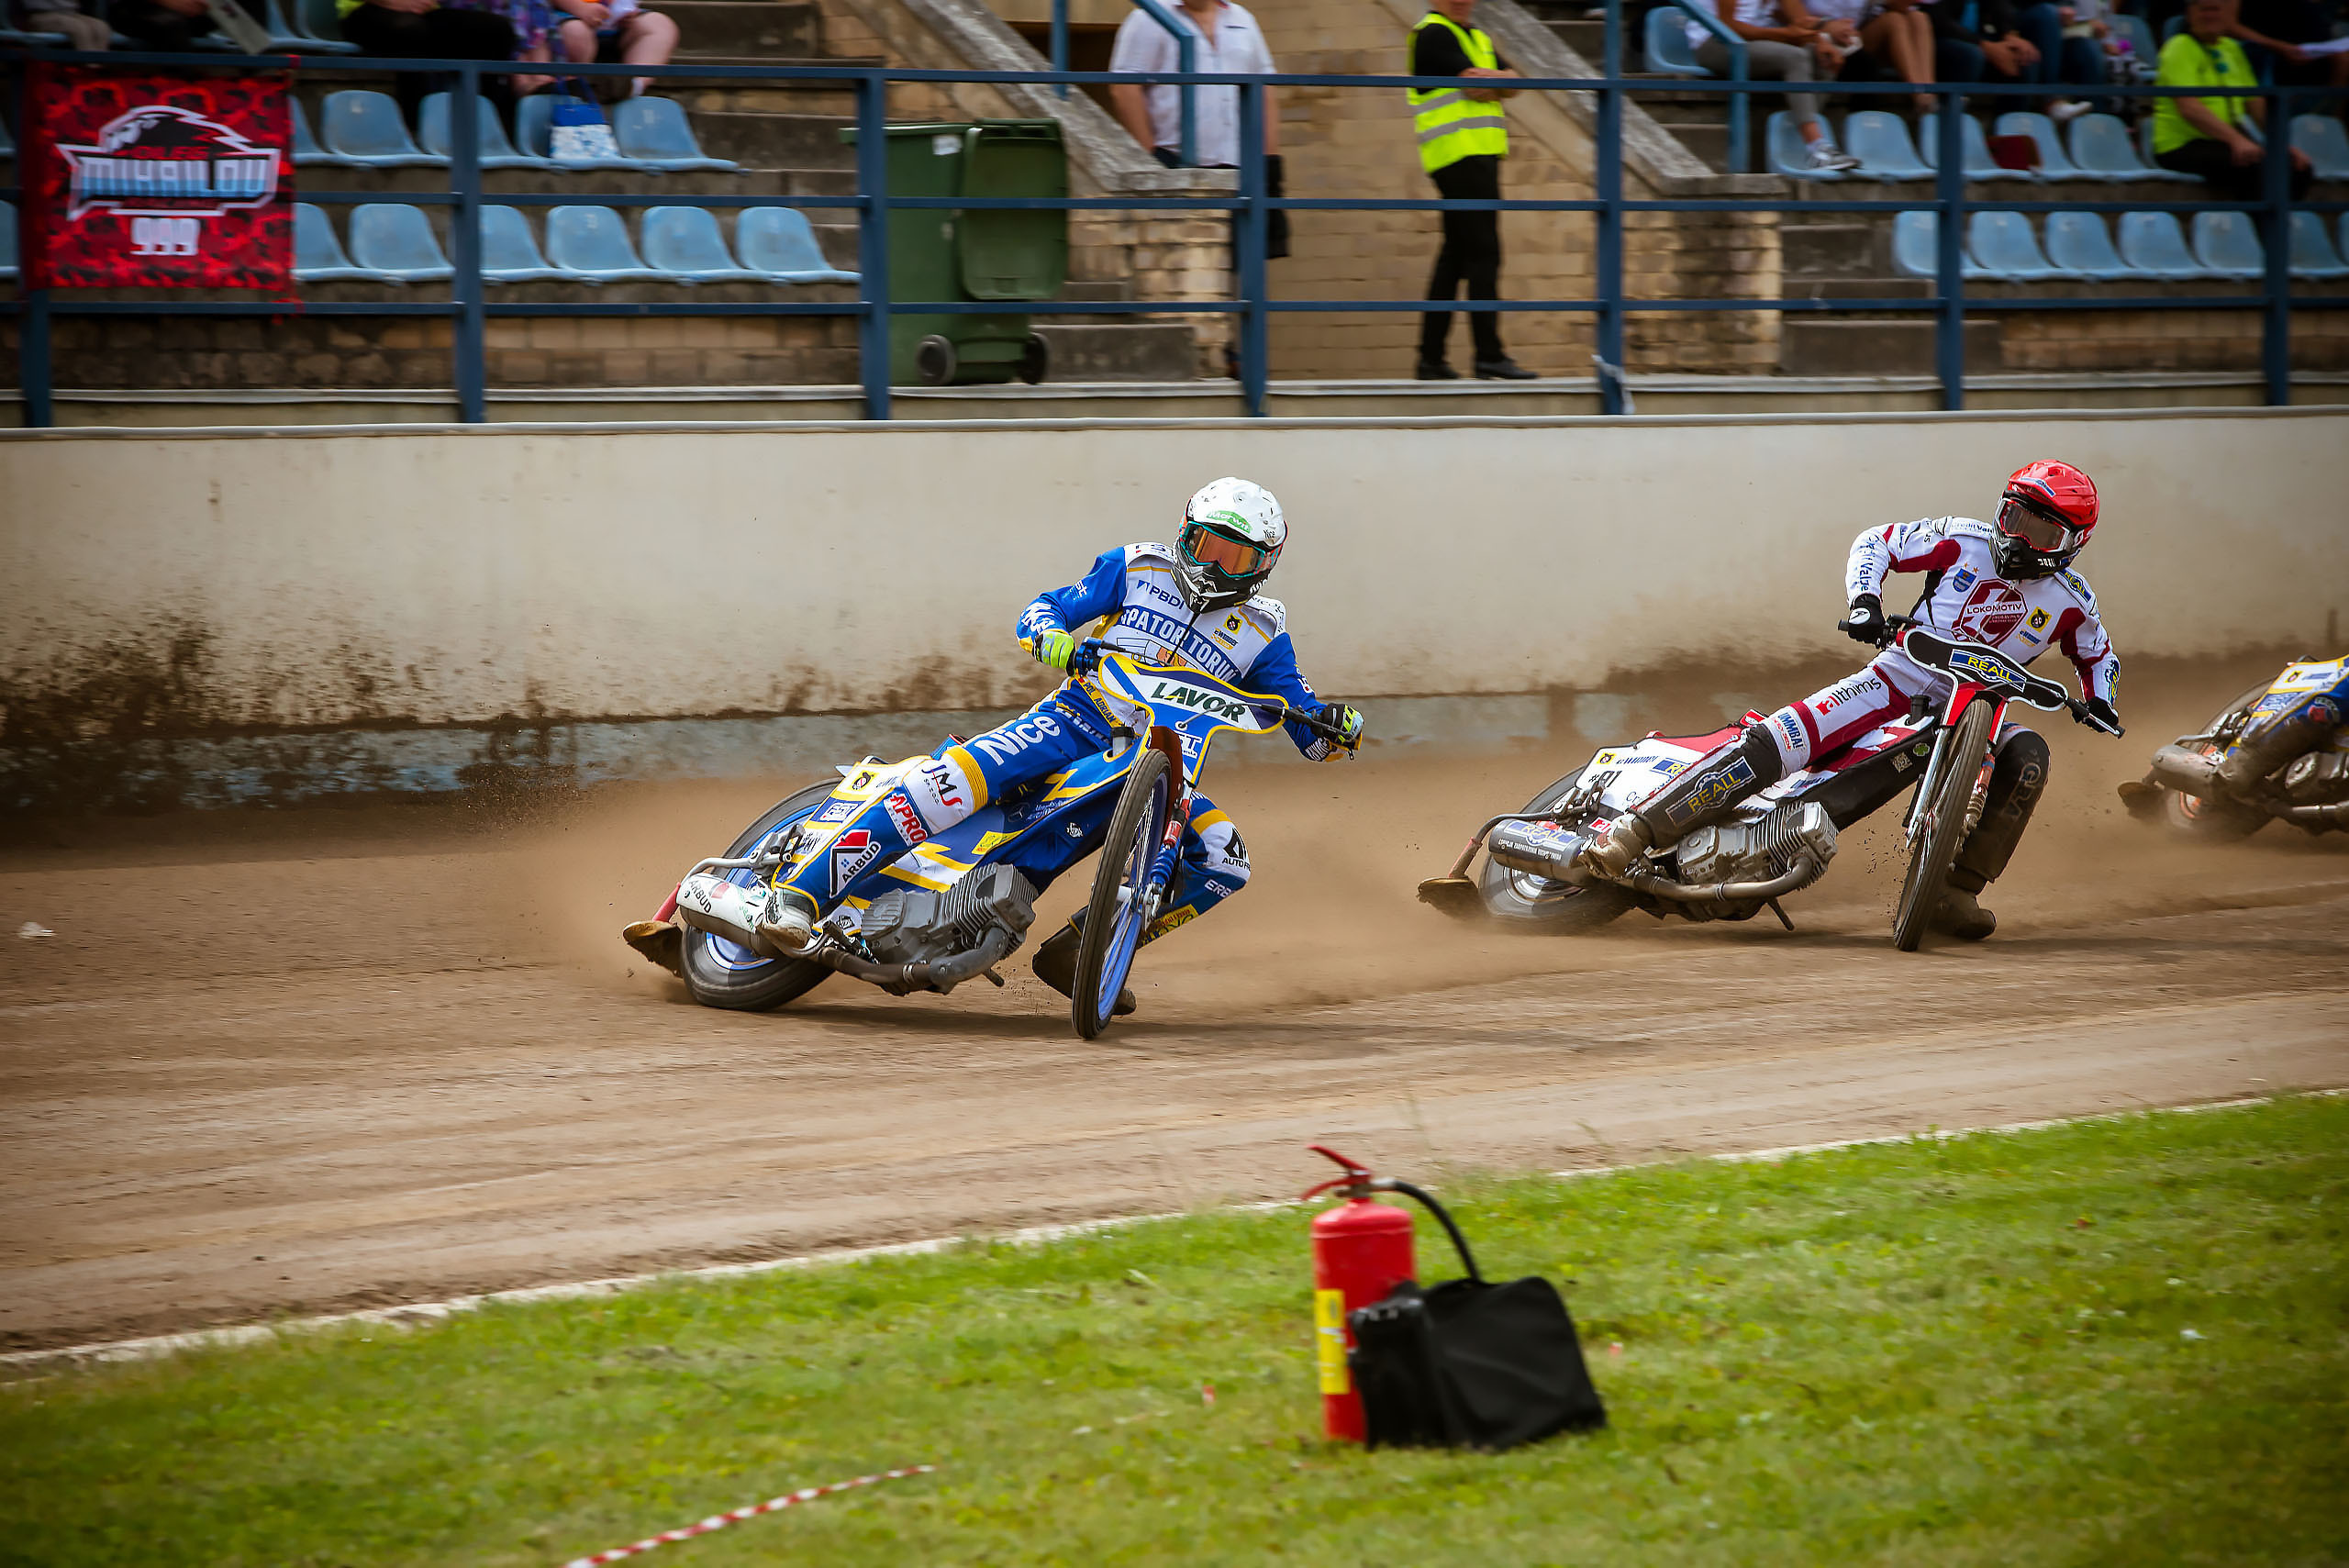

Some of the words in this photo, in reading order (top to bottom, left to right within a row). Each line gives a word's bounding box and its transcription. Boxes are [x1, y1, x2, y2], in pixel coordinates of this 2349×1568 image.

[1149, 585, 1185, 610] PBDI
[1966, 603, 2022, 615] LOKOMOTIV
[1967, 656, 2012, 682] REALL
[1083, 682, 1096, 696] POL
[1093, 697, 1118, 725] ADRIAN
[1151, 682, 1246, 723] LAVOR
[974, 716, 1061, 766] Nice
[921, 764, 963, 806] JMS
[1688, 773, 1742, 814] REALL
[1520, 824, 1565, 842] REALL
[841, 843, 880, 884] ARBUD
[687, 878, 712, 914] ARBUD
[1204, 878, 1234, 898] ERB
